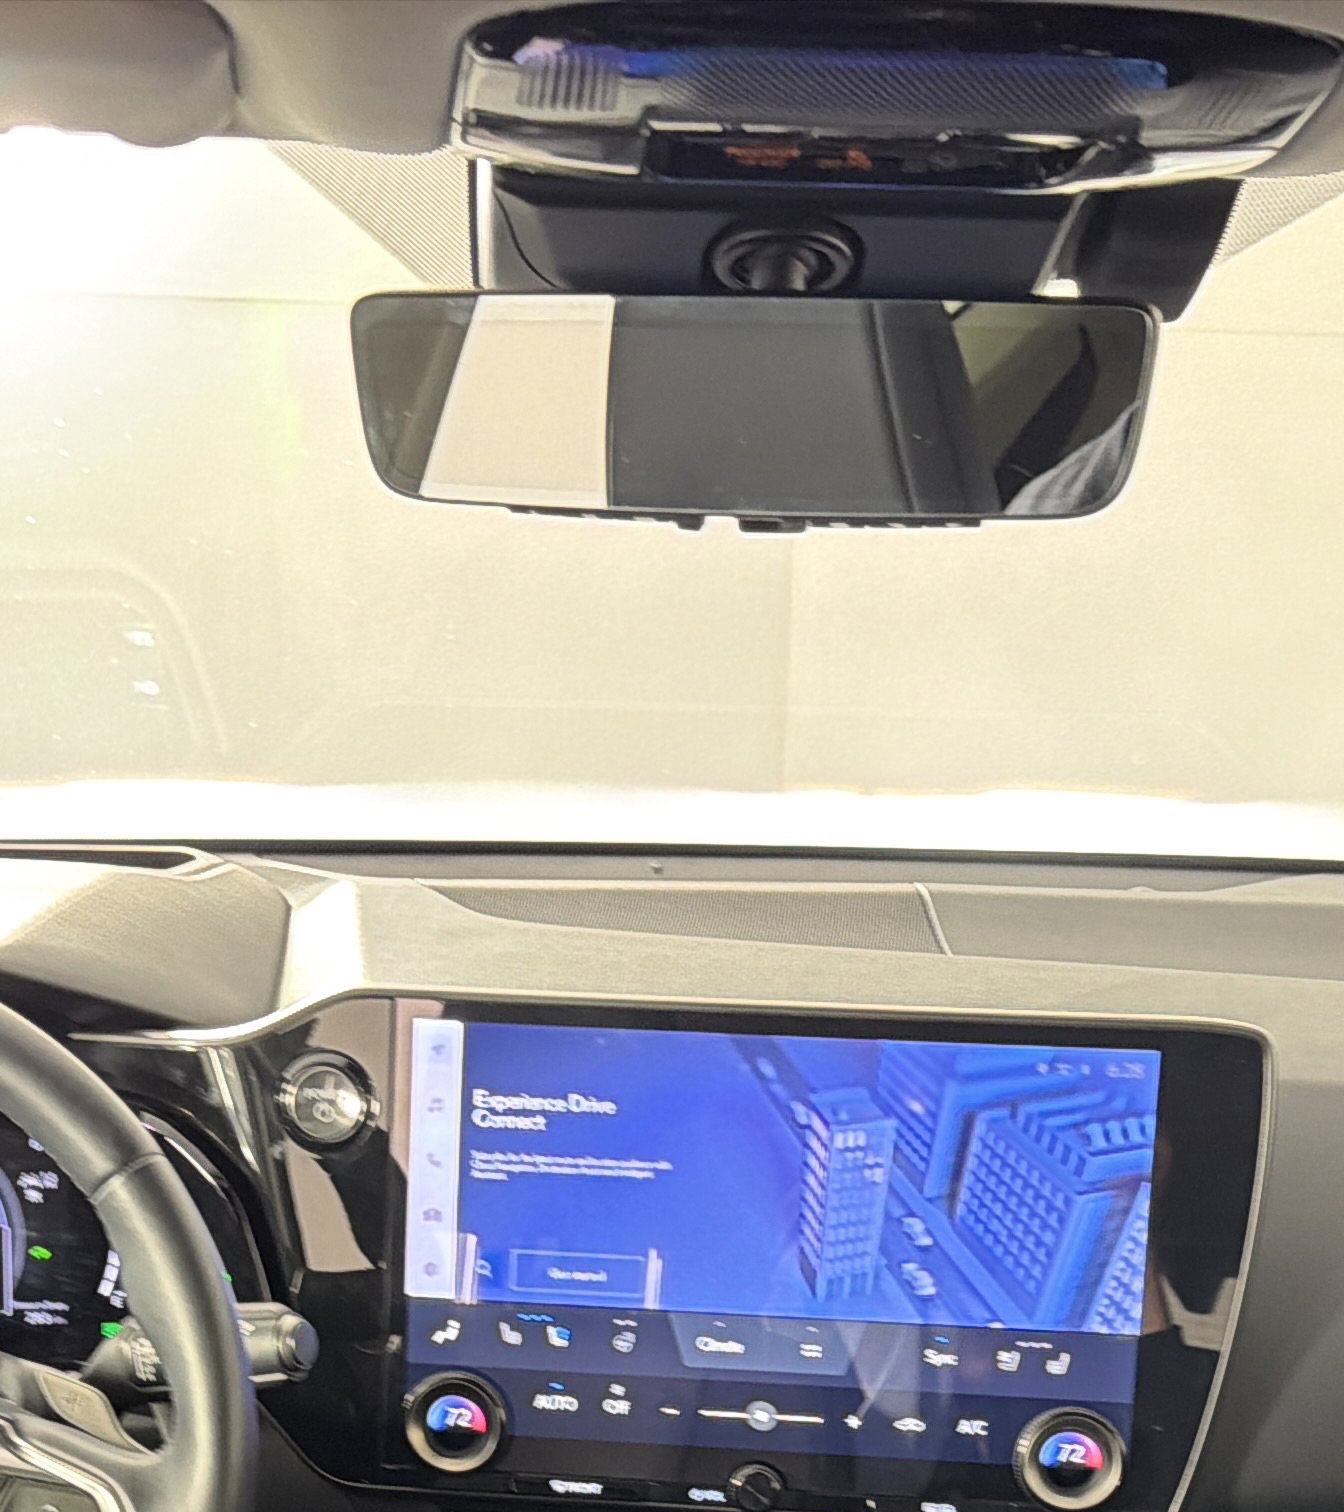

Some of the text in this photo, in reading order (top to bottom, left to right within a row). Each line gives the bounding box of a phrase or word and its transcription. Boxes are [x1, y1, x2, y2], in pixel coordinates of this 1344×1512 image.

[472, 1088, 617, 1114] Experience Drive
[471, 1109, 546, 1131] Connect
[532, 1394, 579, 1412] AUTO
[444, 1406, 474, 1428] 72
[1058, 1442, 1087, 1464] 72
